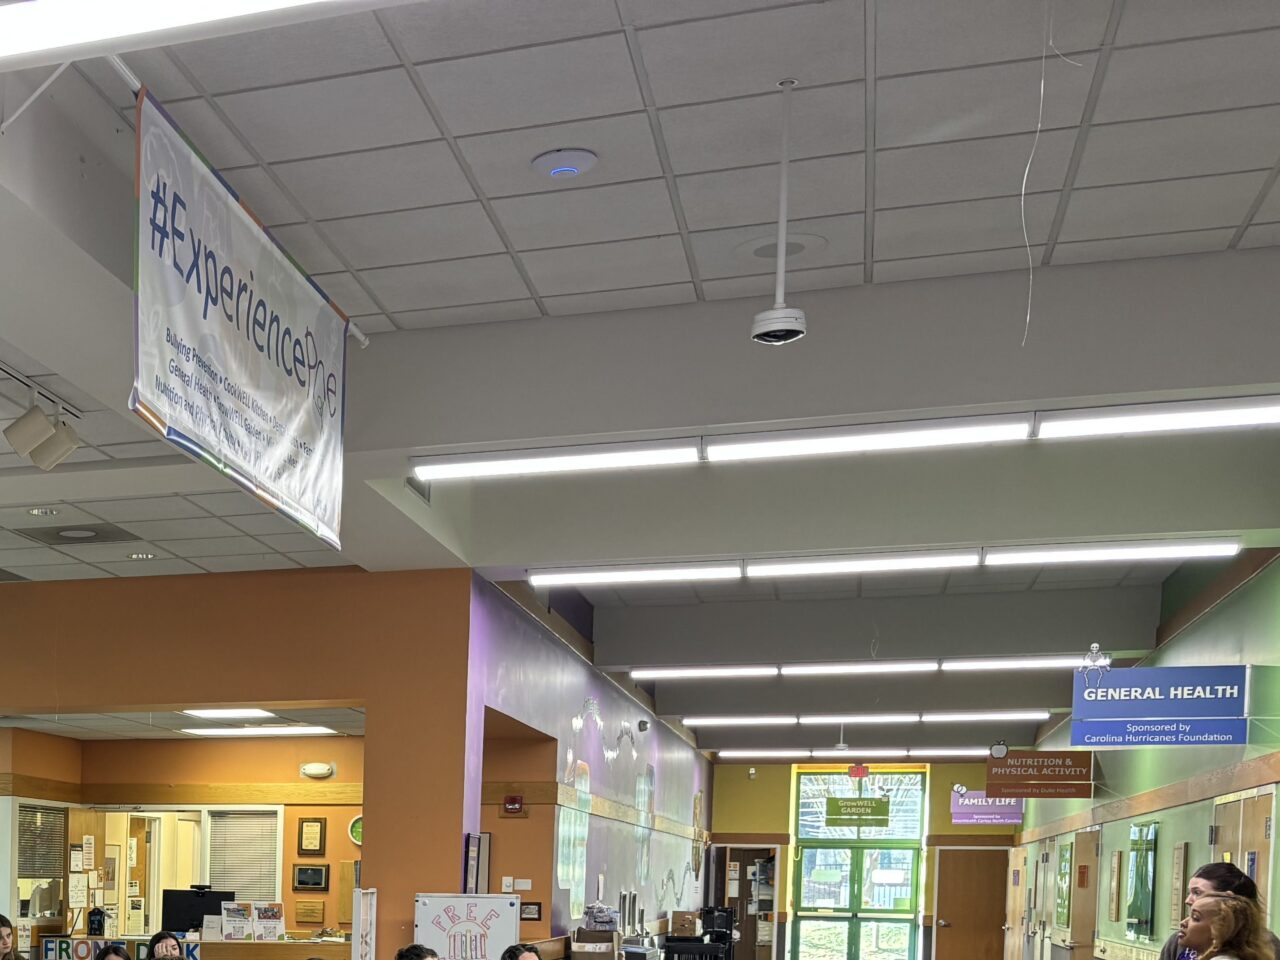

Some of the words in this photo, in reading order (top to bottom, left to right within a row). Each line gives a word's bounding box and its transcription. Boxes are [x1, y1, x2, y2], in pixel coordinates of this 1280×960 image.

[166, 327, 191, 362] Bullying
[192, 348, 218, 385] Prevention
[223, 377, 250, 409] CookWELL
[169, 358, 193, 388] General
[194, 375, 213, 404] Health
[155, 374, 182, 408] Nutrition
[184, 399, 195, 417] and
[1083, 687, 1165, 701] GENERAL
[1169, 685, 1239, 699] HEALTH
[1126, 723, 1176, 733] Sponsored
[1179, 722, 1191, 733] by
[1084, 734, 1123, 743] Carolina
[1125, 734, 1176, 743] Hurricanes
[1178, 733, 1233, 742] Foundation
[1007, 758, 1063, 766] NUTRITION
[992, 767, 1040, 775] PHYSICAL
[1041, 767, 1088, 775] ACTIVITY
[958, 798, 993, 806] FAMILY
[995, 798, 1017, 806] LIFE
[431, 902, 500, 932] FREE
